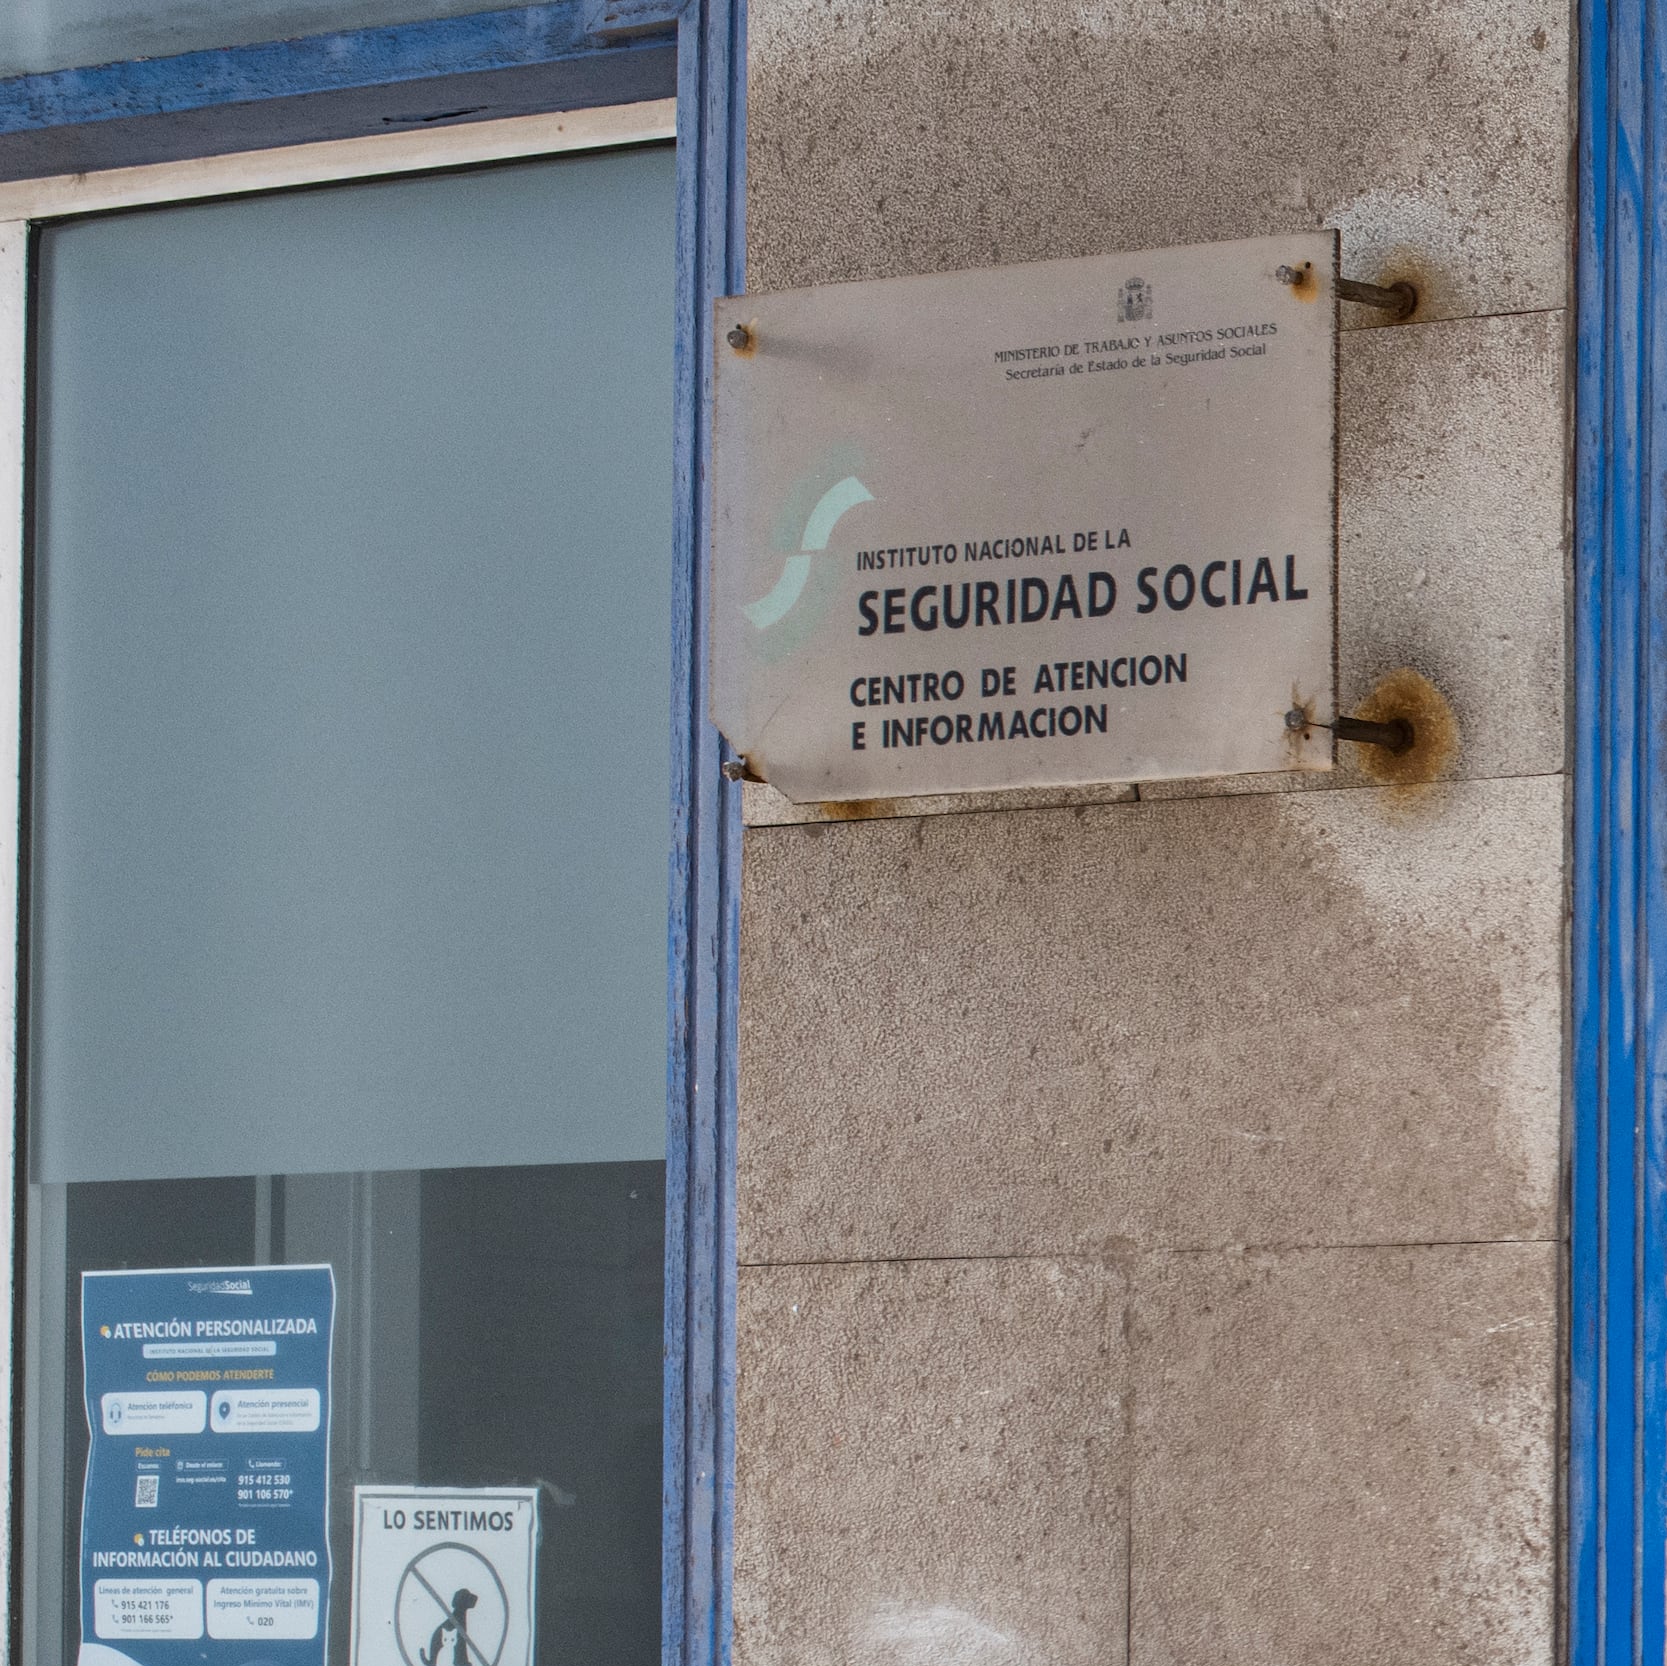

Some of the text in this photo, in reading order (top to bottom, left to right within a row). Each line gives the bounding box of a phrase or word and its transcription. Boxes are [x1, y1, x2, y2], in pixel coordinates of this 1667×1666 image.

[994, 323, 1277, 363] MINISTERIO DE TRABAJO Y ASUNTOS SOCIALES
[1069, 360, 1083, 373] de
[1088, 357, 1128, 372] Estado
[1132, 356, 1146, 367] de
[1150, 353, 1161, 366] la
[1165, 348, 1225, 368] Seguridad
[1230, 343, 1266, 358] Social
[856, 528, 1131, 571] INSTITUTO NACIONAL DE LA
[857, 552, 1310, 637] SEGURIDAD SOCIAL
[850, 652, 1188, 708] CENTRO DE ATENCION
[852, 703, 1109, 751] E INFORMACION
[114, 1317, 317, 1339] ATENCIÓN PERSONALIZADA
[176, 1370, 221, 1381] PODEMOS
[223, 1369, 274, 1380] ATENDERTE
[271, 1400, 309, 1410] presencial
[238, 1475, 291, 1485] 915 412 530
[237, 1490, 253, 1500] 901
[256, 1490, 272, 1500] 106
[384, 1509, 514, 1531] LO SENTIMOS
[150, 1525, 256, 1545] TELÉFONOS DE
[93, 1548, 318, 1567] INFORMACIÓN AL CIUDADANO
[122, 1586, 131, 1595] de
[132, 1586, 163, 1595] atención
[166, 1586, 194, 1598] general
[220, 1586, 308, 1598] Atención gratuita sobre
[121, 1601, 170, 1610] 915 421 176
[214, 1598, 314, 1611] Ingreso Vital (IMV)
[121, 1615, 136, 1624] 901
[138, 1615, 153, 1624] 166
[258, 1617, 274, 1626] 020
